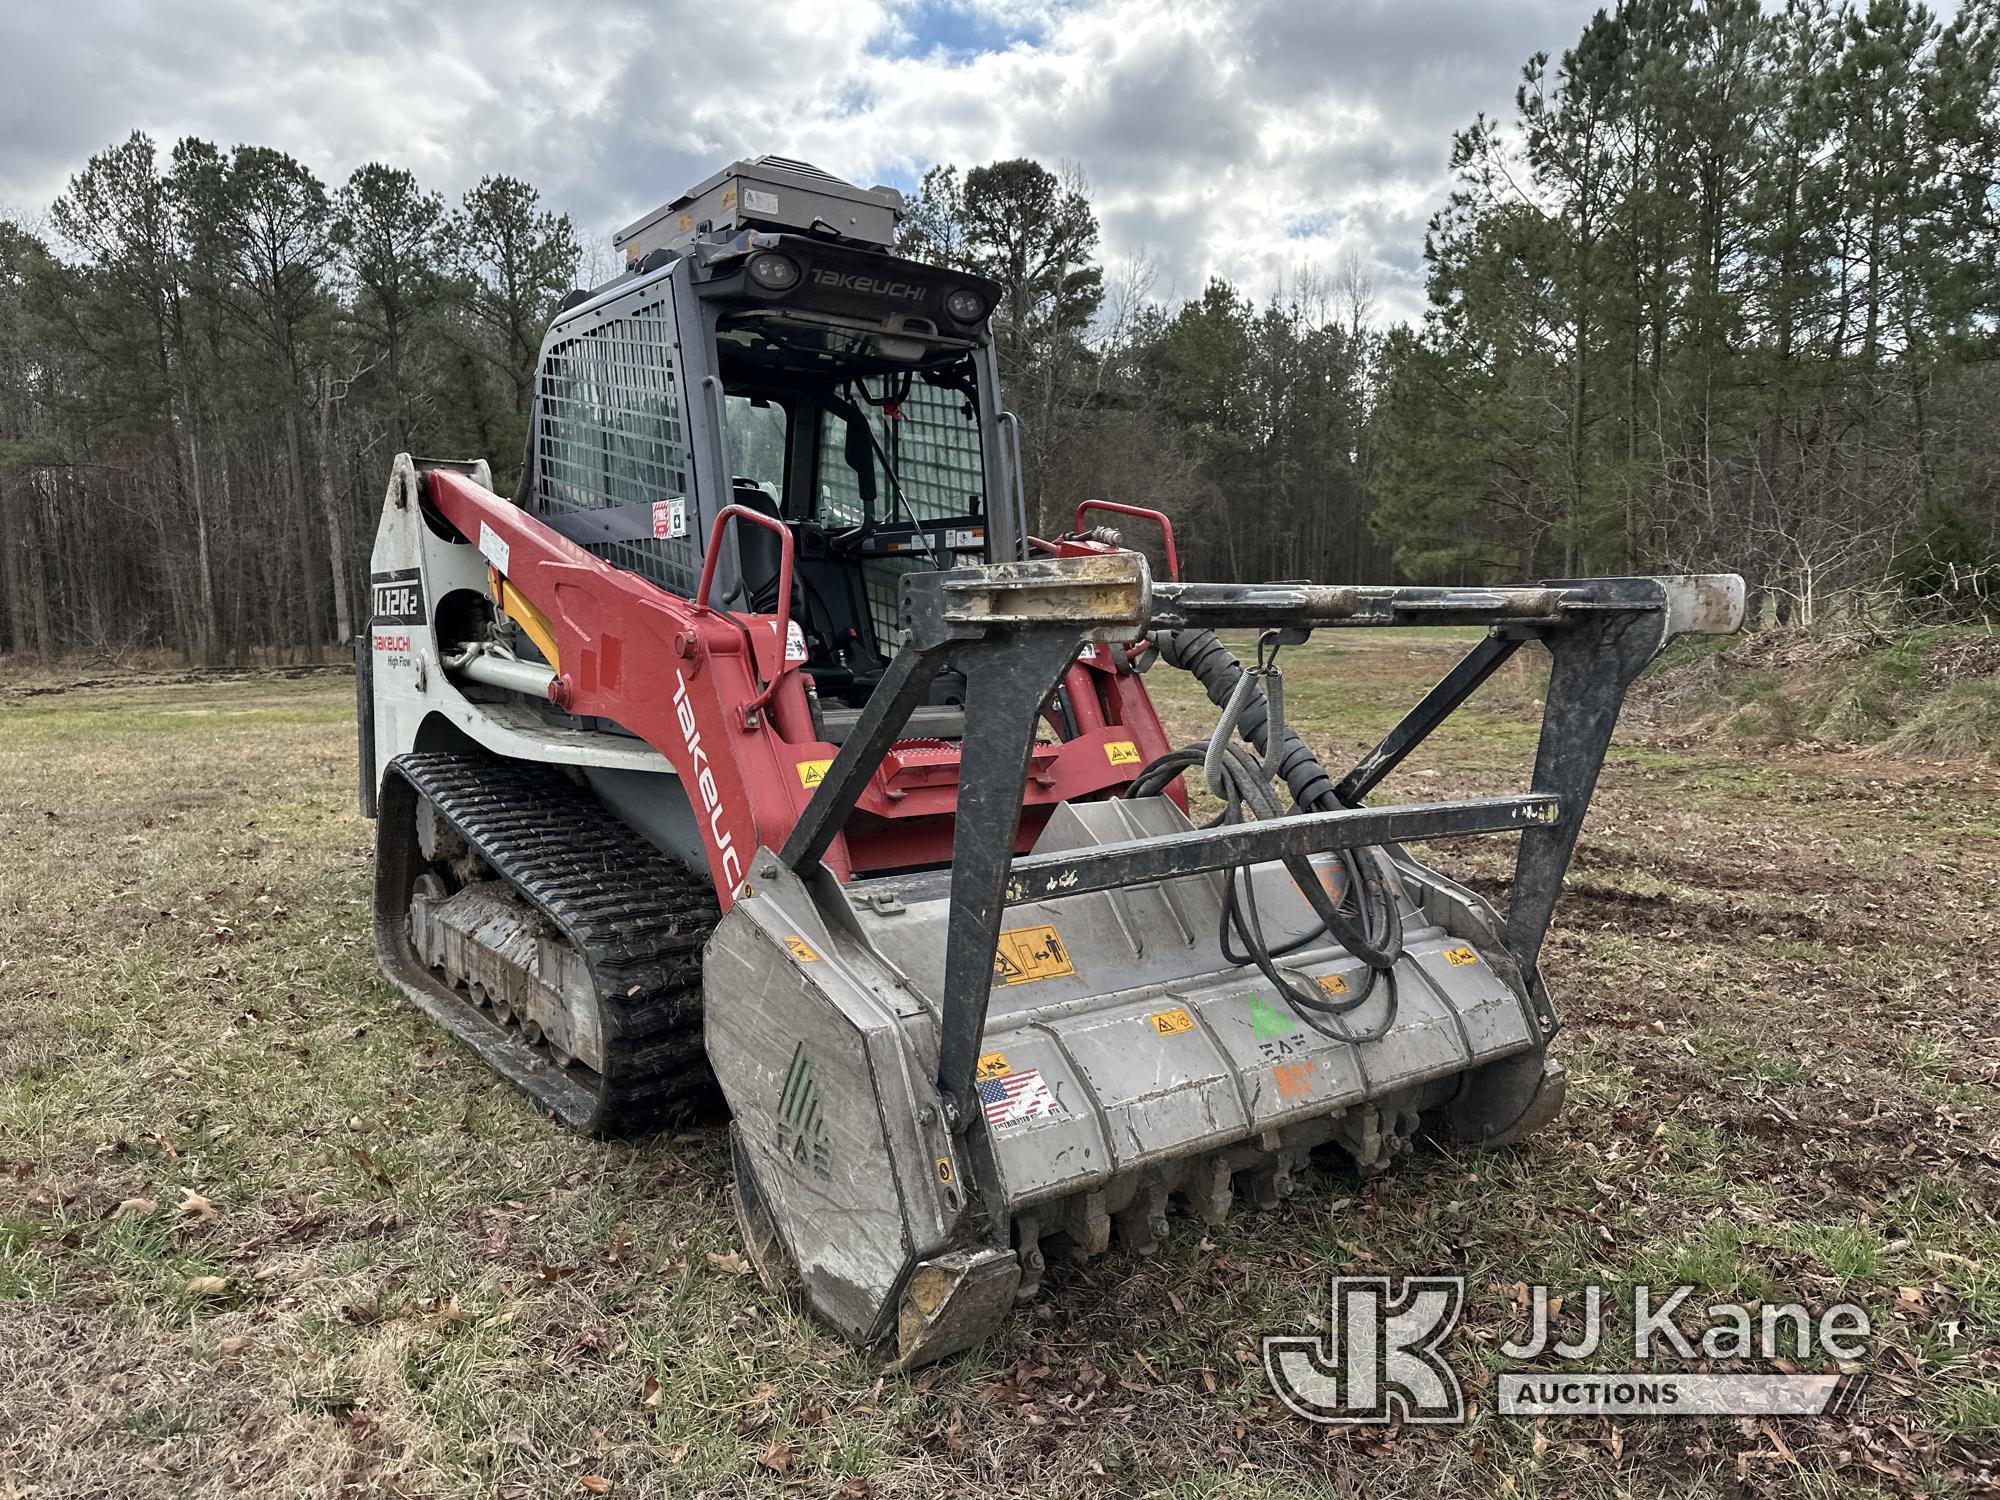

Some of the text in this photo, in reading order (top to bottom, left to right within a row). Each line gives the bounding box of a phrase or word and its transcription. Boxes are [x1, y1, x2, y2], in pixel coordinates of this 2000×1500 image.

[811, 268, 927, 301] TAKEUCHI
[387, 656, 411, 669] High Flow
